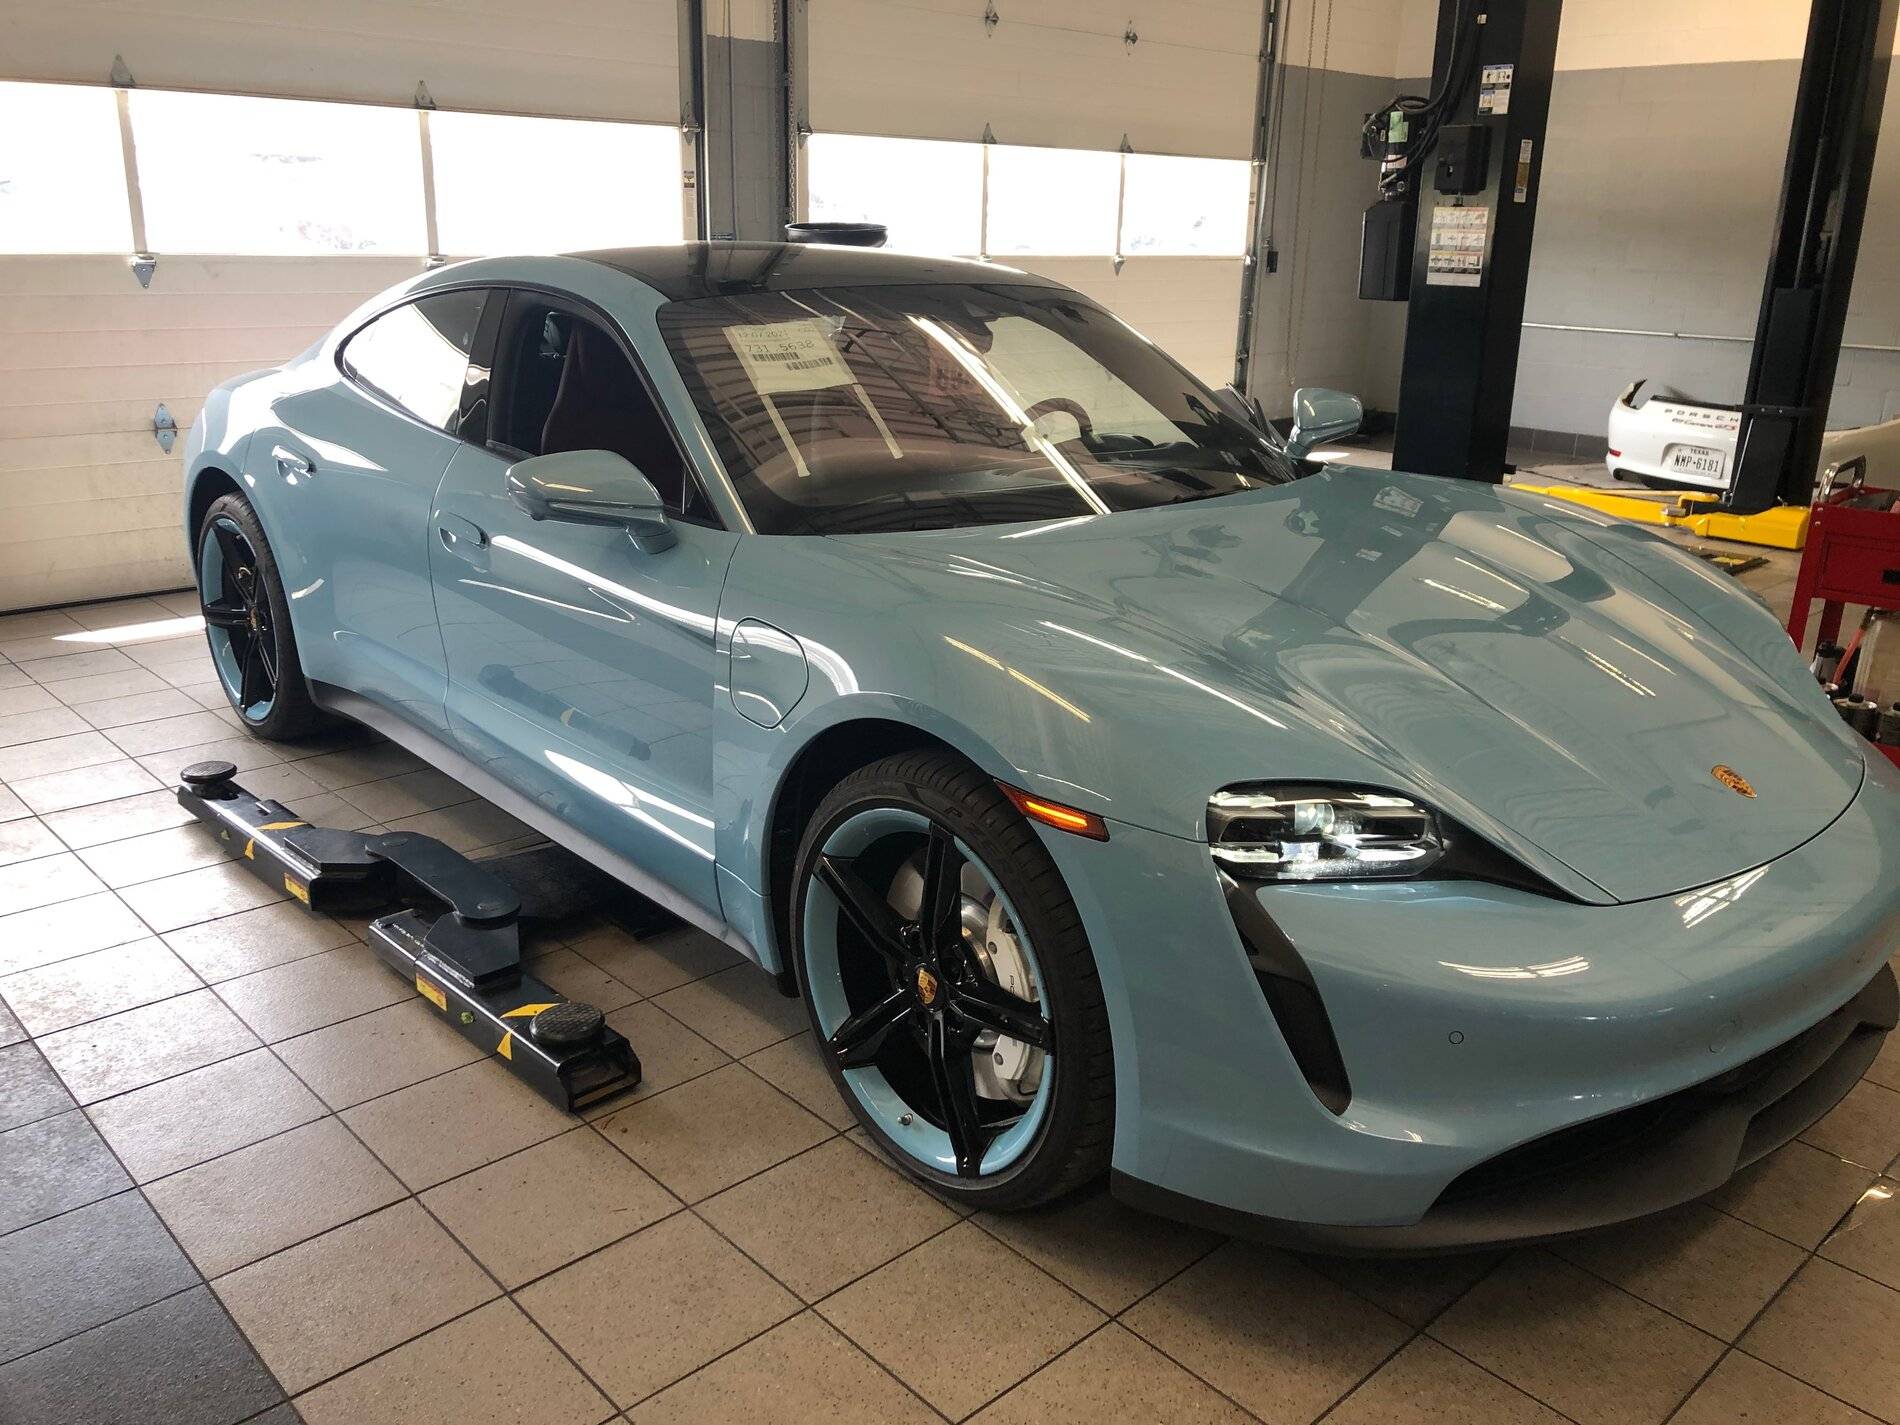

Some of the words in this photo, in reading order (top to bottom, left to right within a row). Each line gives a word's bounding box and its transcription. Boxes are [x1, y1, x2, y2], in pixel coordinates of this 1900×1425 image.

[744, 343, 769, 353] 731
[1664, 409, 1739, 422] PORSCH
[1690, 448, 1710, 456] TEXAS
